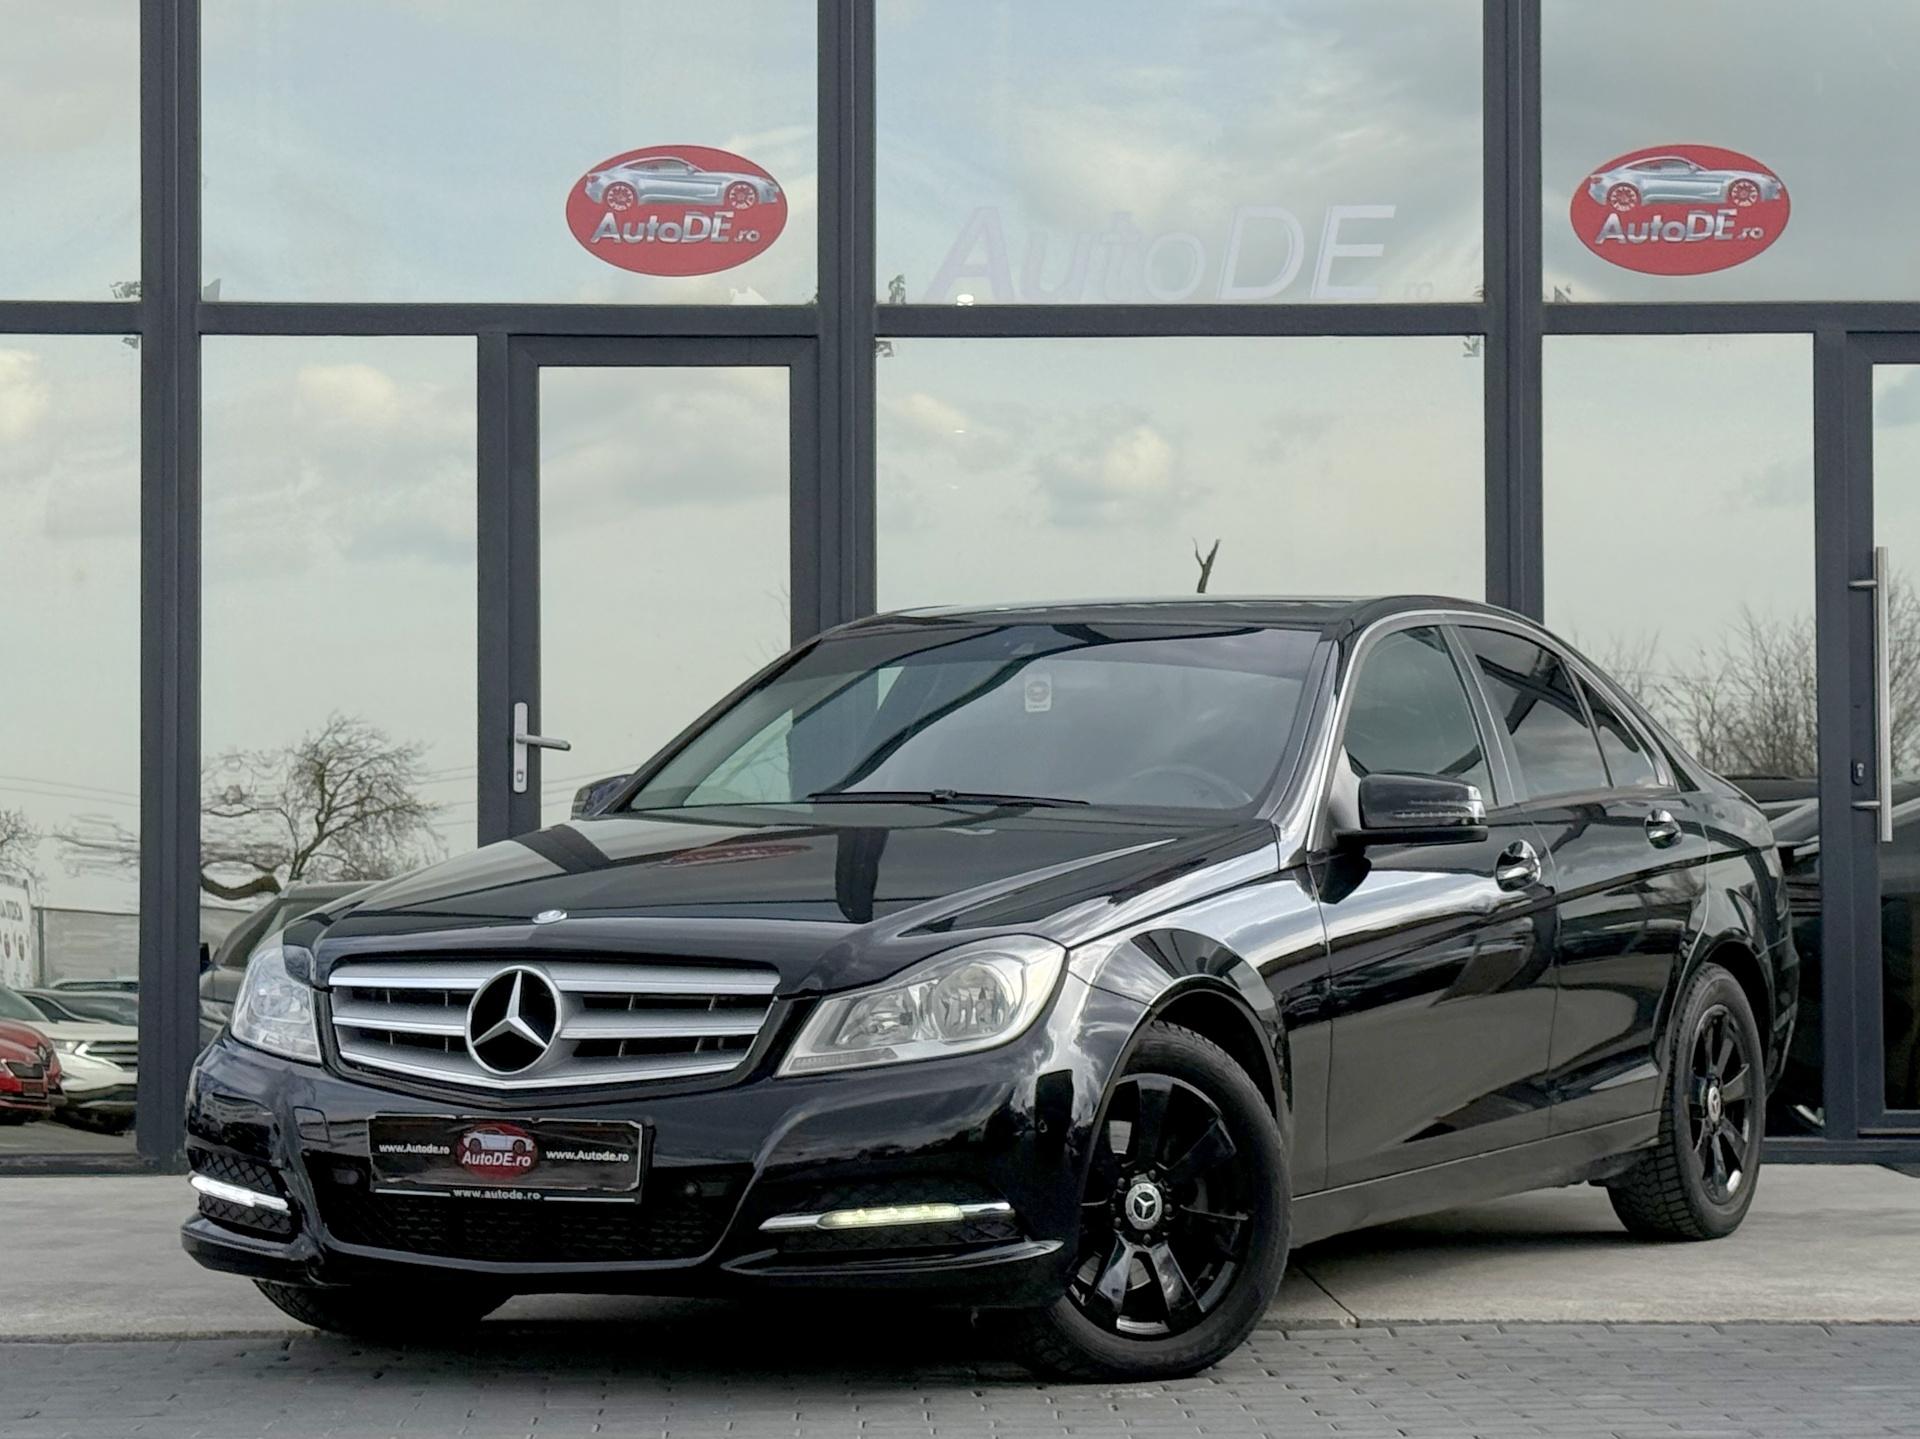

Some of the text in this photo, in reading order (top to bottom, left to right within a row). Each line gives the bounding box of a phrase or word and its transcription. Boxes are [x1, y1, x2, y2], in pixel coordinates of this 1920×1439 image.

[378, 1143, 451, 1155] www.Autode.ro
[461, 1150, 532, 1168] AutoDE.ro
[545, 1149, 630, 1163] www.Autode.ro
[452, 1187, 542, 1200] www.autode.ro
